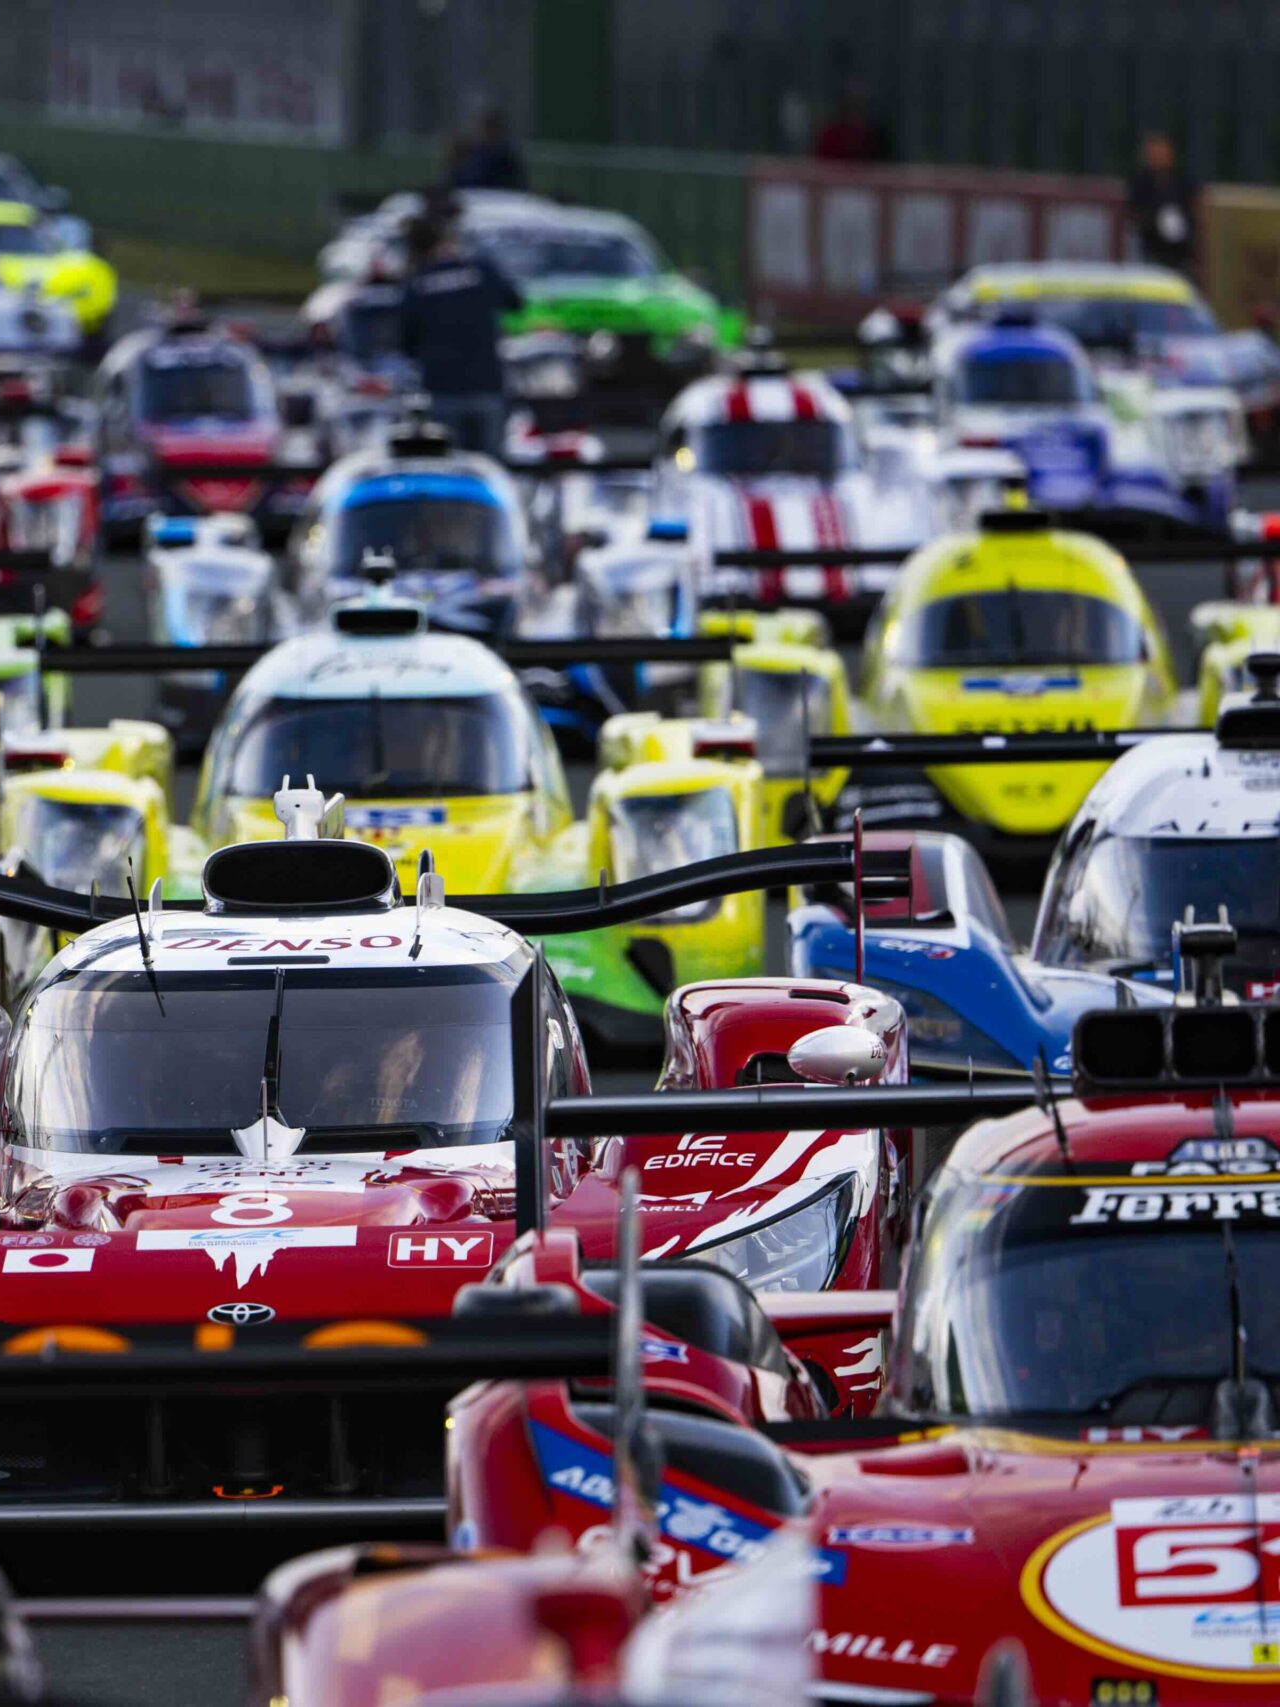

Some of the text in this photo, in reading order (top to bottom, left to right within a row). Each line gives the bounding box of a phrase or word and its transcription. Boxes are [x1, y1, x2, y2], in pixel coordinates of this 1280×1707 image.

[163, 934, 403, 952] DENSO
[643, 1152, 757, 1170] EDIFICE
[211, 1192, 294, 1226] 8
[396, 1237, 484, 1262] HY
[804, 1629, 957, 1669] MILLE
